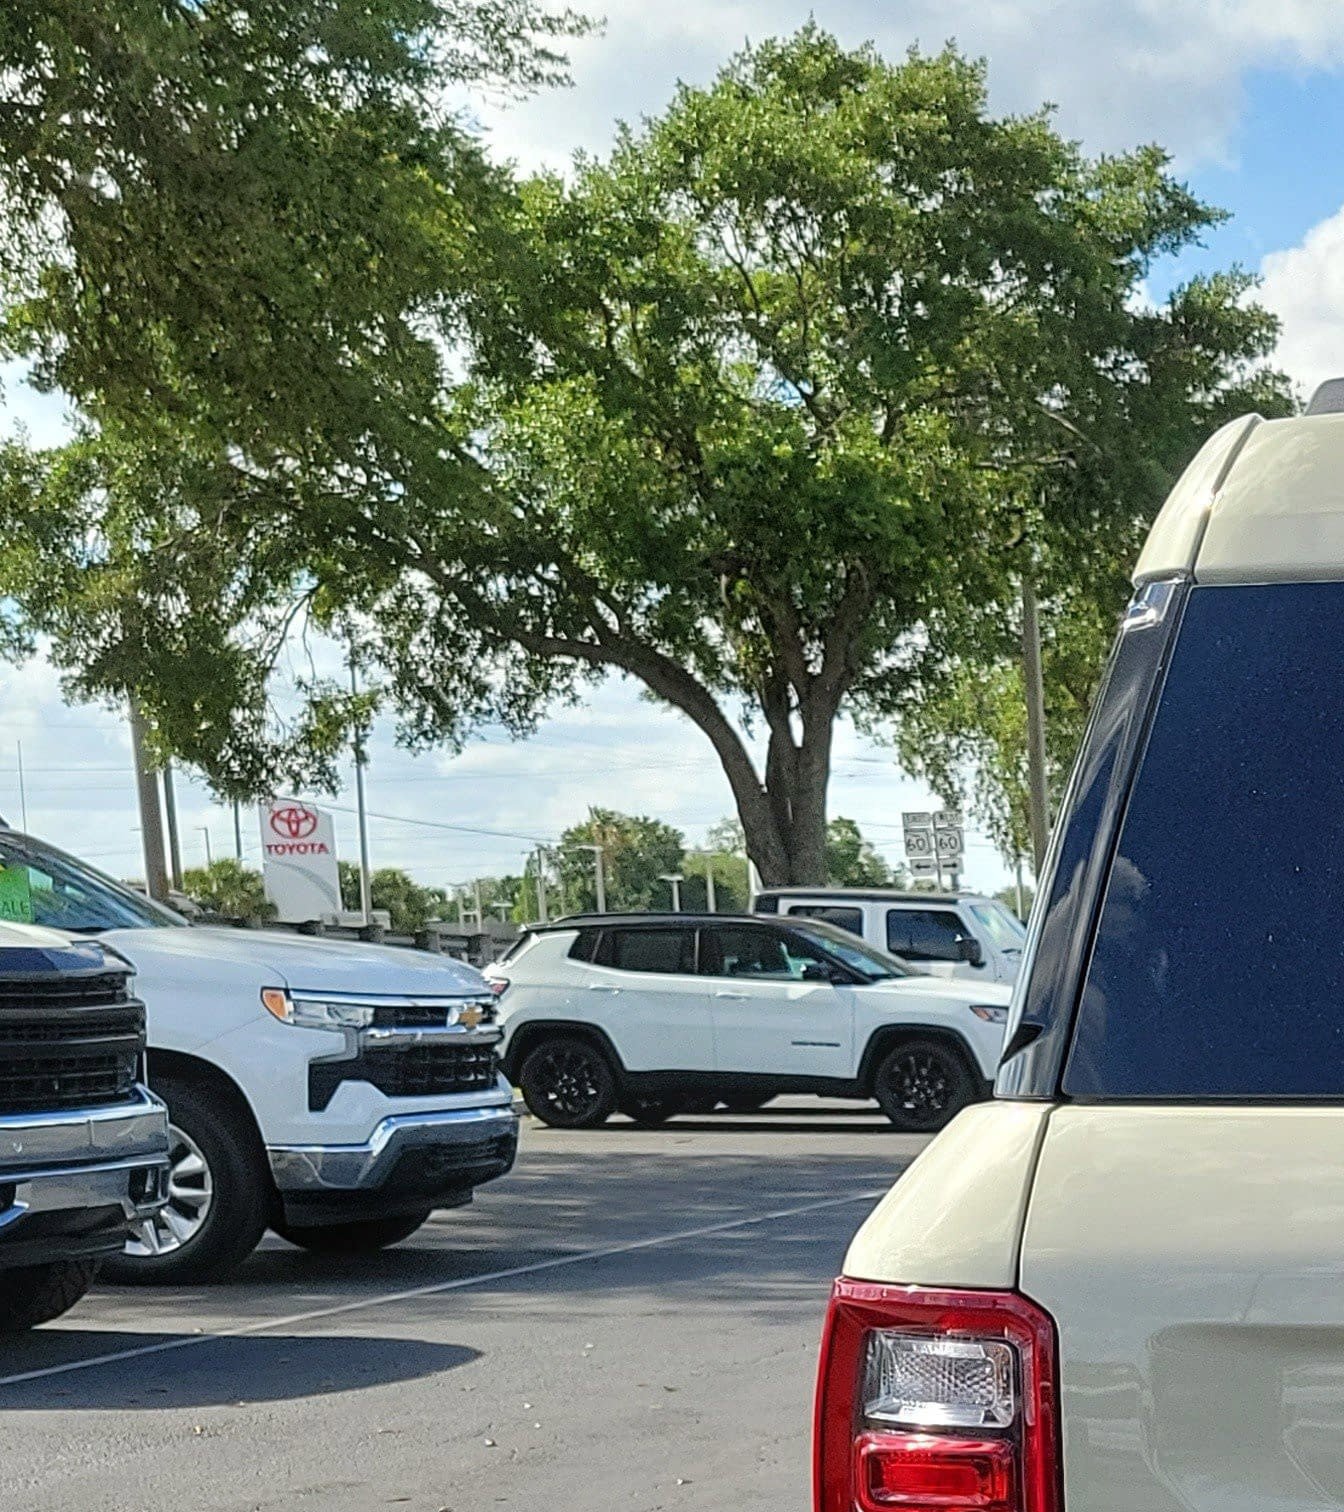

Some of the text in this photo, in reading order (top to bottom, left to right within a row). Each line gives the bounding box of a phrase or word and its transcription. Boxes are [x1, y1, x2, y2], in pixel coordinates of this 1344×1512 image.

[907, 838, 926, 851] 60
[939, 836, 958, 849] 60
[266, 843, 329, 856] TOYOTA
